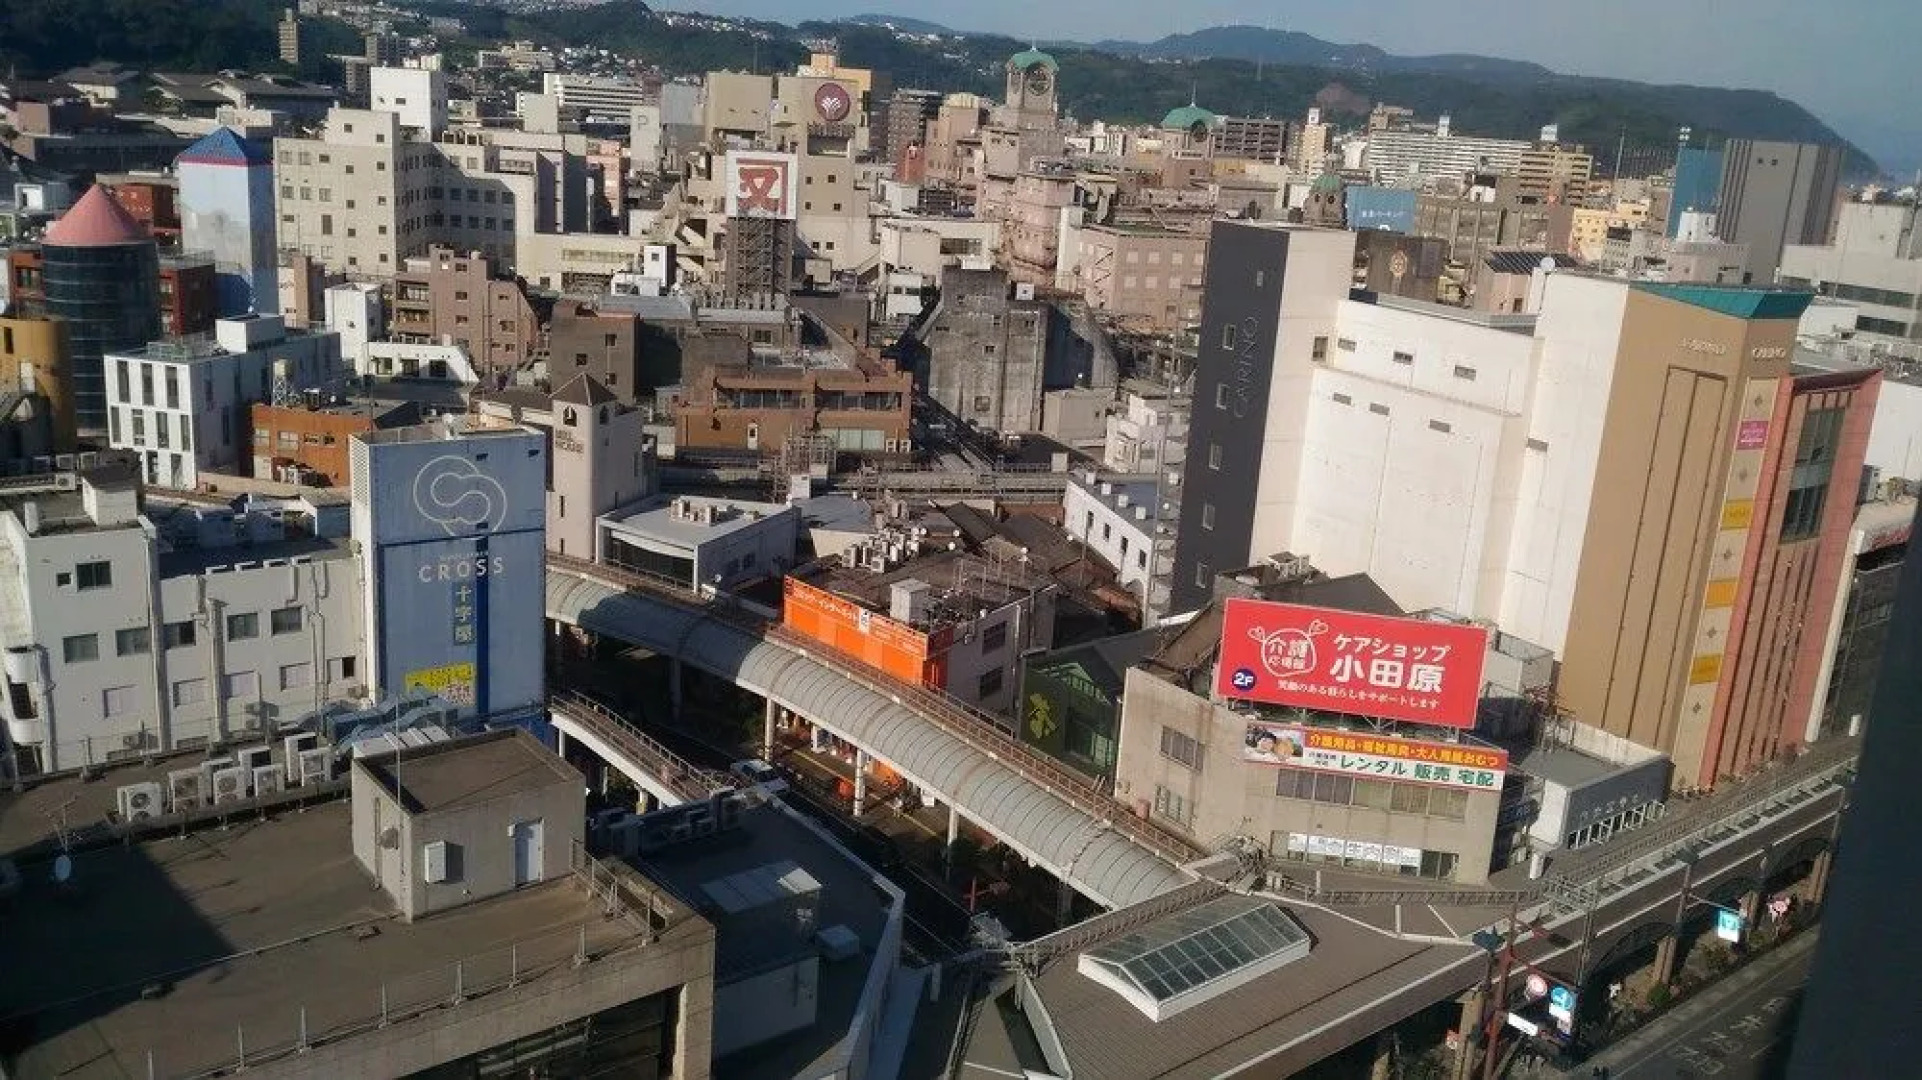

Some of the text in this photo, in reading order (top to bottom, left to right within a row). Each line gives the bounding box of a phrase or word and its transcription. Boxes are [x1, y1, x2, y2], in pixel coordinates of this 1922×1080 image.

[418, 556, 504, 583] CROSS
[1333, 632, 1451, 661] ケアショップ
[1233, 672, 1254, 685] 2F
[1329, 654, 1448, 694] 小田原
[1340, 754, 1408, 776] レンタル
[1414, 763, 1451, 780] 販売
